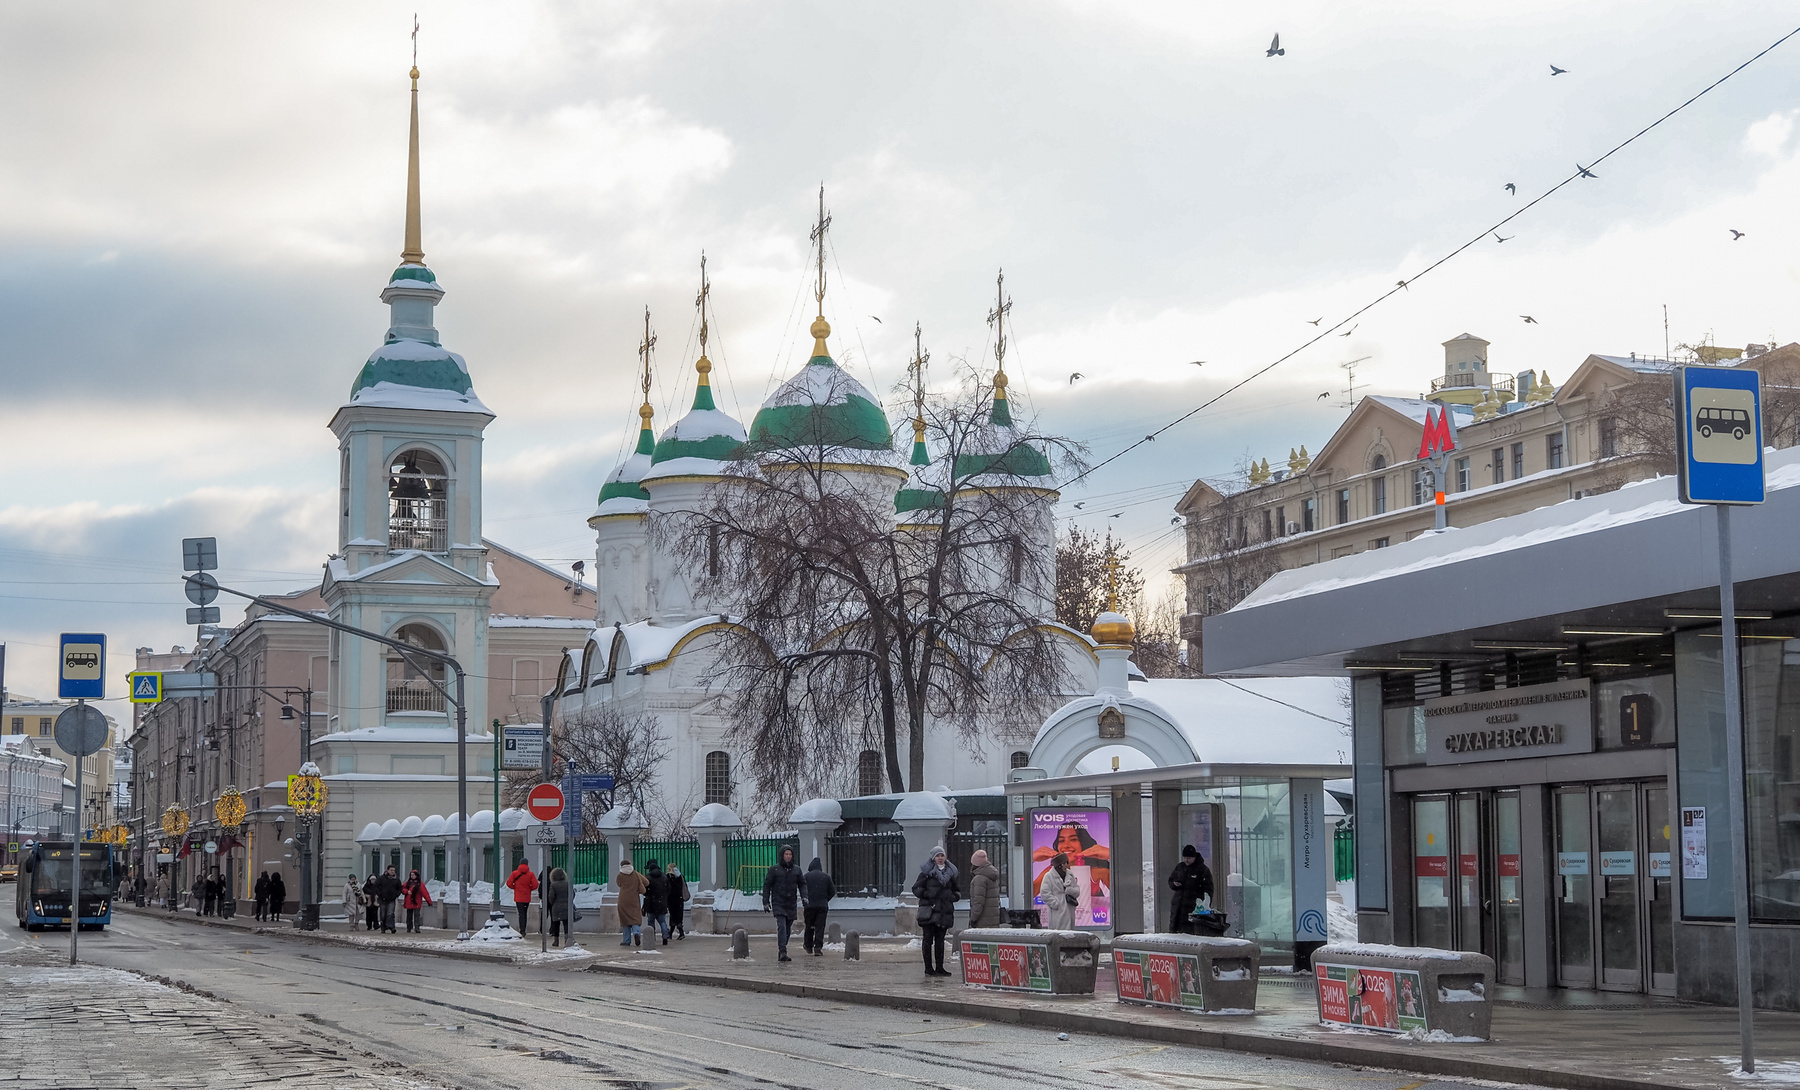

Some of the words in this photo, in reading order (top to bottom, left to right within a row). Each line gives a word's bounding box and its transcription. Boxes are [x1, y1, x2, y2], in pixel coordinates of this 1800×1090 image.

[1417, 405, 1455, 459] М
[1630, 702, 1638, 731] 1
[1445, 724, 1558, 753] СУХАРЕВСКАЯ
[1034, 814, 1065, 822] VOIS
[1093, 910, 1107, 919] wb
[998, 948, 1019, 961] 2026
[966, 957, 988, 971] ЗИМА
[1149, 958, 1170, 974] 2026
[967, 971, 971, 979] В
[971, 972, 989, 980] МОСКВЕ
[1119, 967, 1141, 984] ЗИМА
[1125, 984, 1142, 994] МОСКВЕ
[1357, 974, 1386, 993] 2026
[1322, 984, 1346, 1005] ЗИМА
[1324, 1004, 1328, 1013] В
[1327, 1004, 1347, 1017] МОСКВЕ
